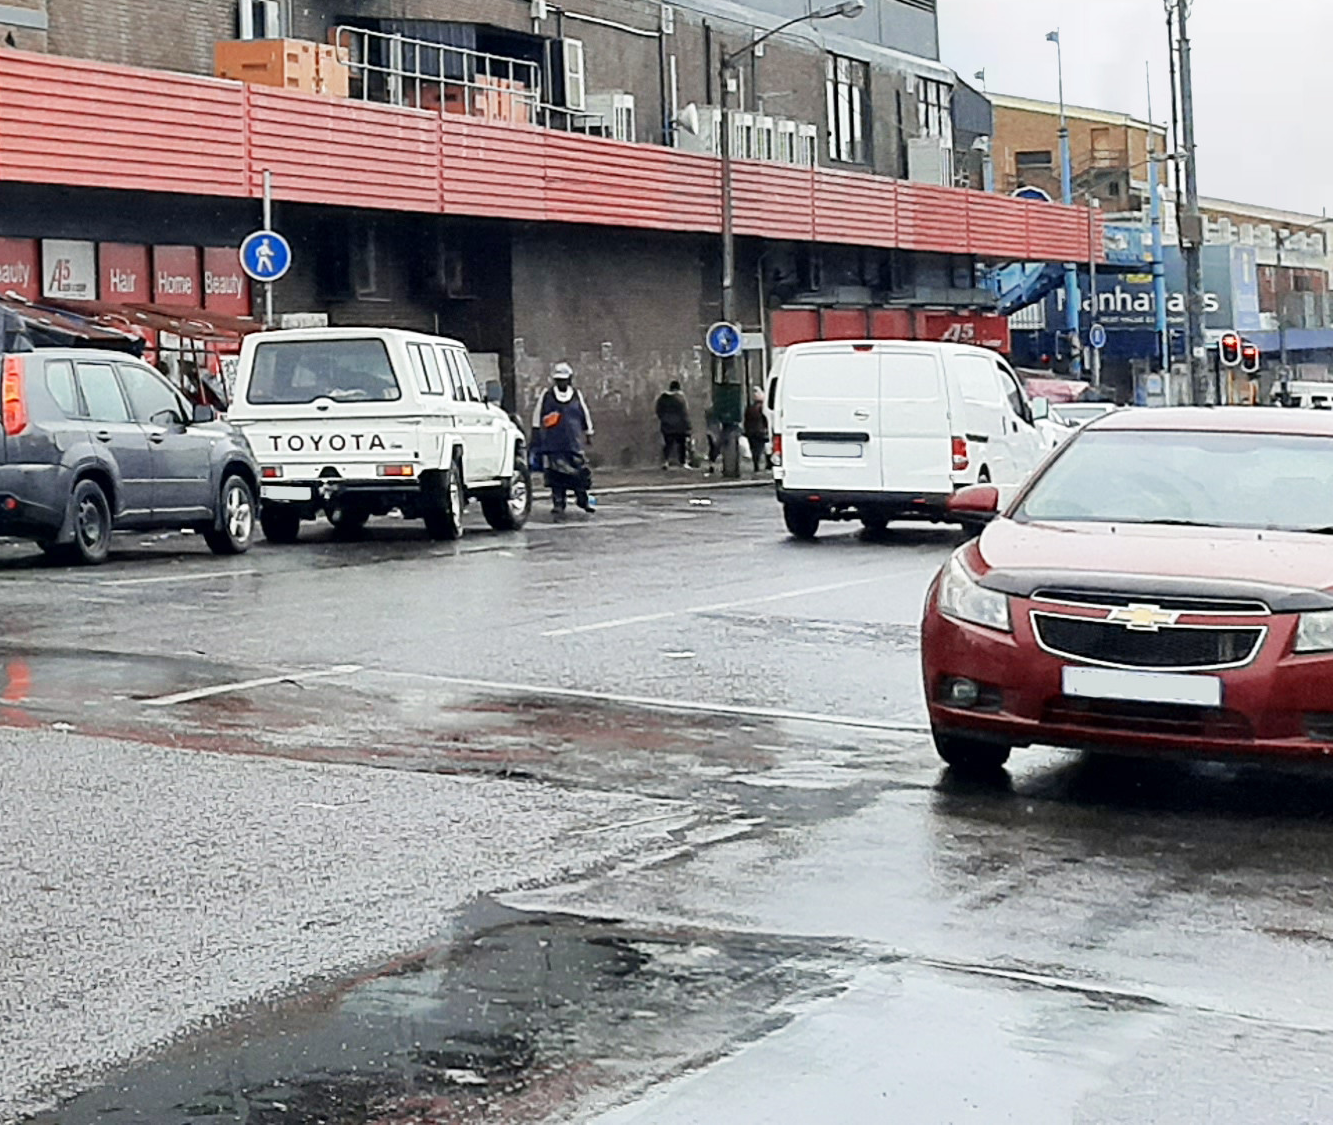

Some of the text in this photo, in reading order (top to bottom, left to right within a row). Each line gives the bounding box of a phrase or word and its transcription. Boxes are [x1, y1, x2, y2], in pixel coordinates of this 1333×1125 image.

[48, 259, 70, 291] A5
[110, 269, 137, 292] Hair
[158, 272, 193, 294] Home
[204, 272, 242, 298] Beauty
[269, 435, 385, 451] TOYOTA
